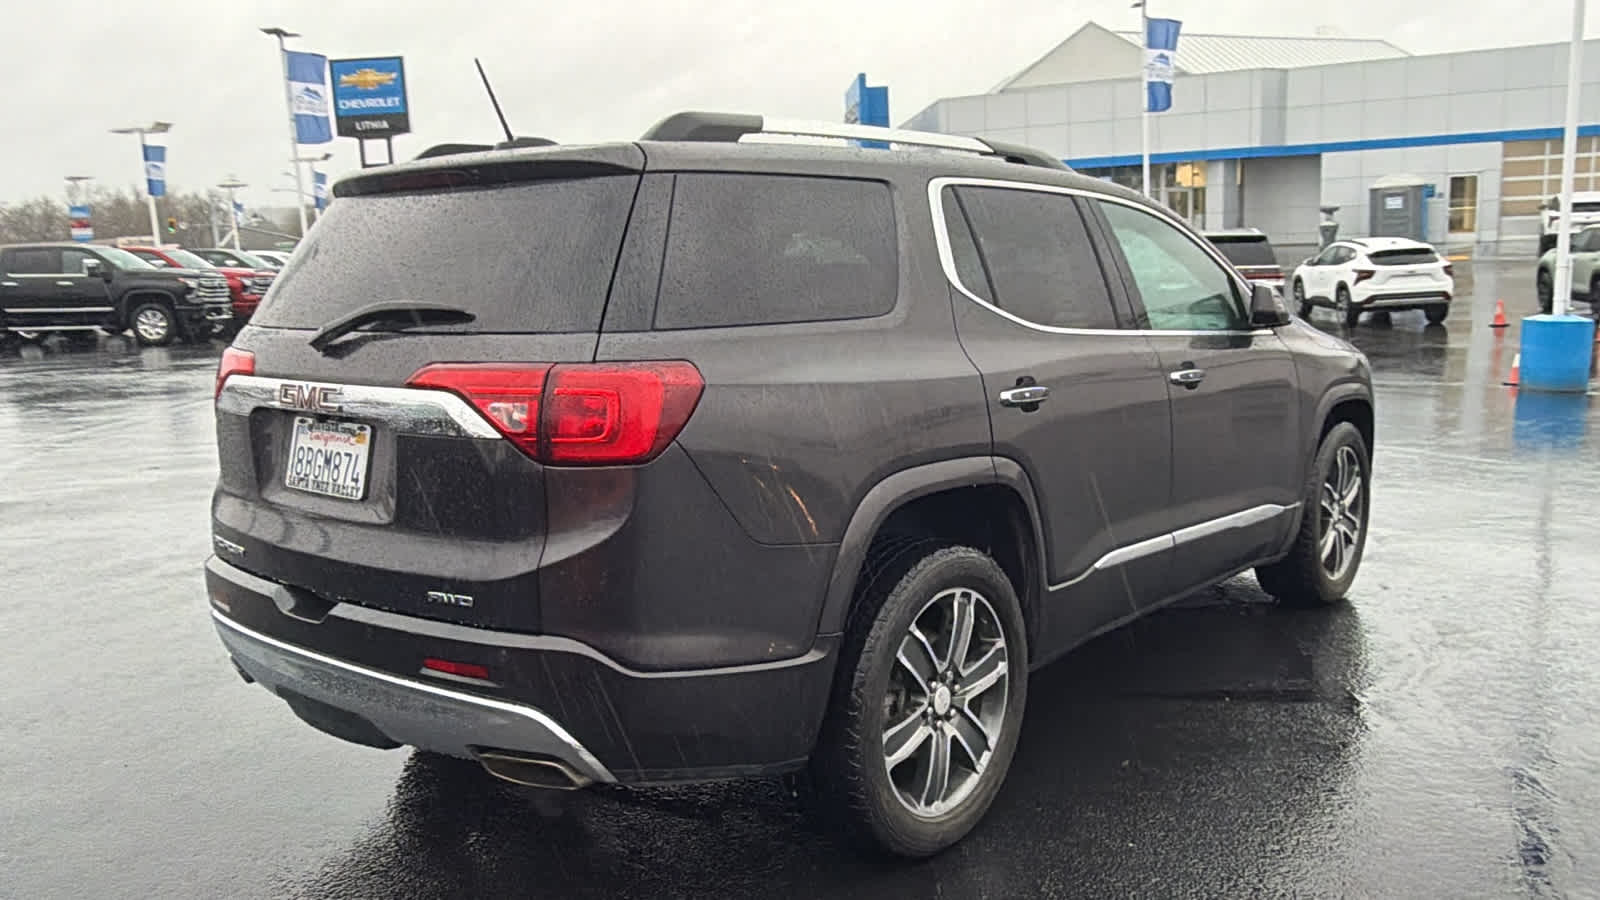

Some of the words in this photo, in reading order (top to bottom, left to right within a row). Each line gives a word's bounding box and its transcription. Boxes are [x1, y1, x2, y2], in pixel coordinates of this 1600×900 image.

[339, 97, 400, 109] CHEVROLET
[355, 120, 389, 131] LITHIA
[280, 383, 342, 413] GMC
[294, 445, 361, 485] 8BGM874
[426, 591, 474, 607] AWD
